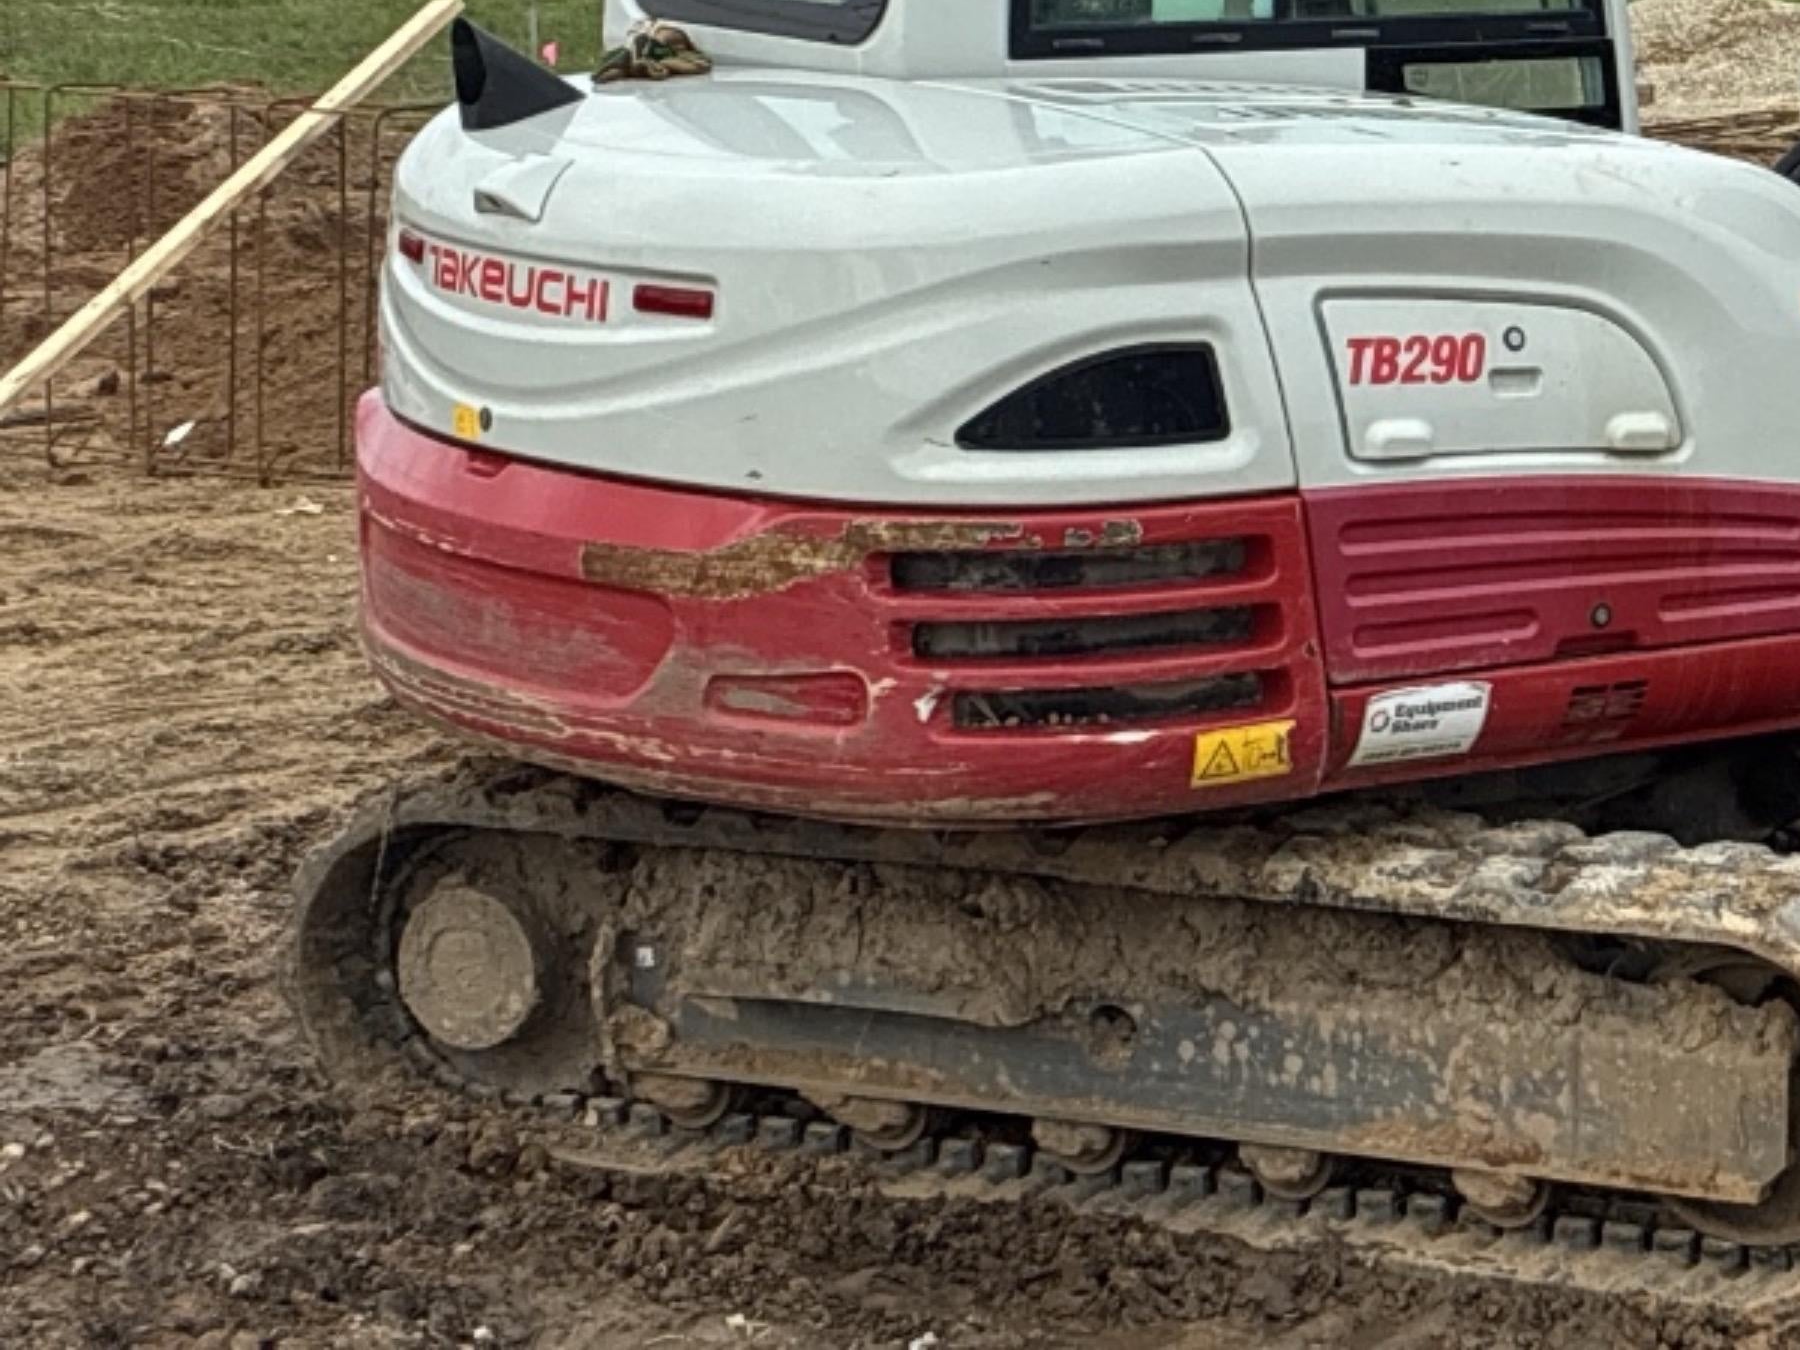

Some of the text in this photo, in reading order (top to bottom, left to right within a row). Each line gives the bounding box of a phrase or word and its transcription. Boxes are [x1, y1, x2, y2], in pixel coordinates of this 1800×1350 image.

[1346, 332, 1486, 386] TB290
[1394, 695, 1484, 719] Equipment
[1390, 719, 1439, 734] Share
